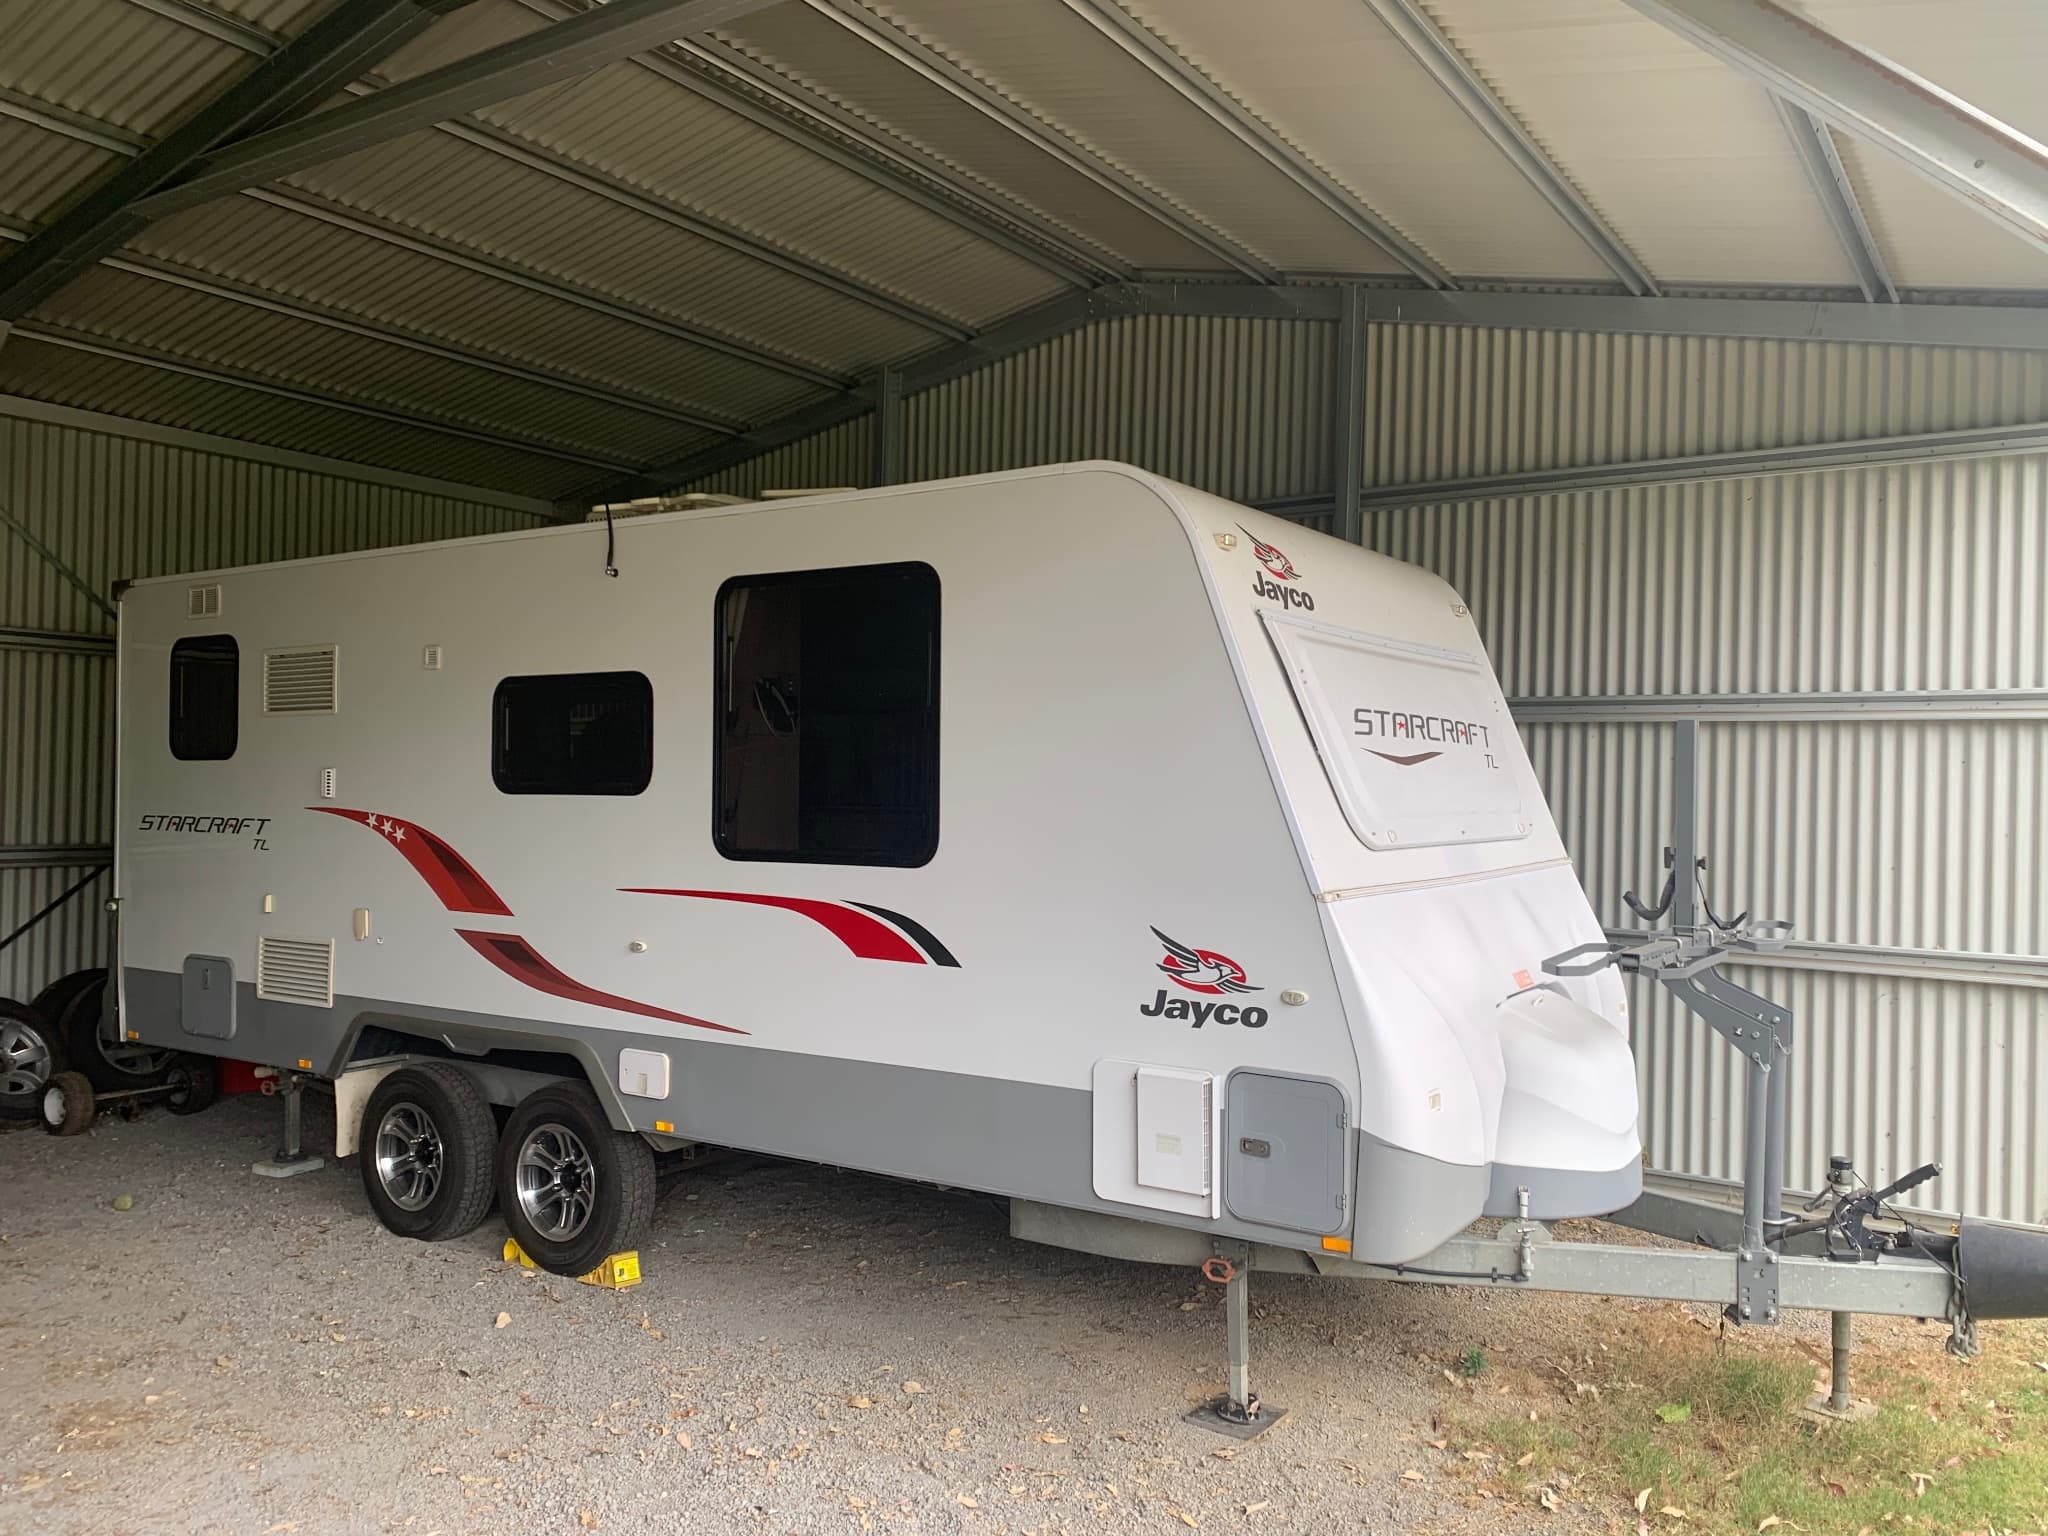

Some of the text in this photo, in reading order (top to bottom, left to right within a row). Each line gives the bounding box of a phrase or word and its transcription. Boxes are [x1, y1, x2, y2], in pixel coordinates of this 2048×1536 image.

[1252, 570, 1315, 611] Jayco
[1354, 708, 1488, 748] STARCRAFT
[1484, 754, 1499, 768] TL
[139, 815, 271, 835] STARCRAFT
[252, 839, 270, 850] TL
[1140, 989, 1269, 1029] Jayco
